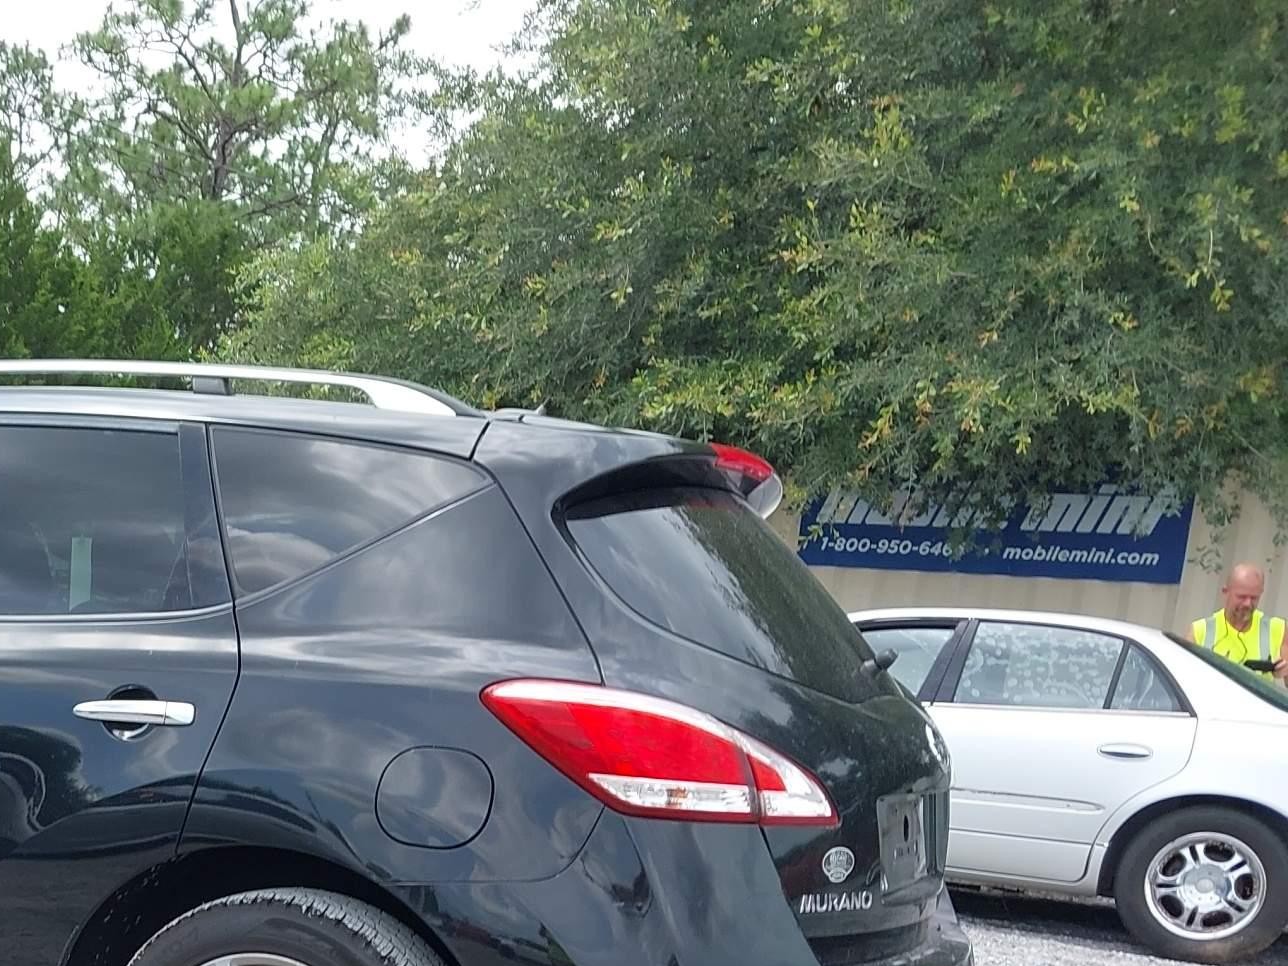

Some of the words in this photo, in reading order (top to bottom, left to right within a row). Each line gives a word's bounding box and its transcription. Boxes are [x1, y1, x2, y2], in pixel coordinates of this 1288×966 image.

[821, 537, 966, 557] 1-800-950-646
[1002, 545, 1160, 566] mobilemini.com
[799, 890, 873, 914] MURANO
